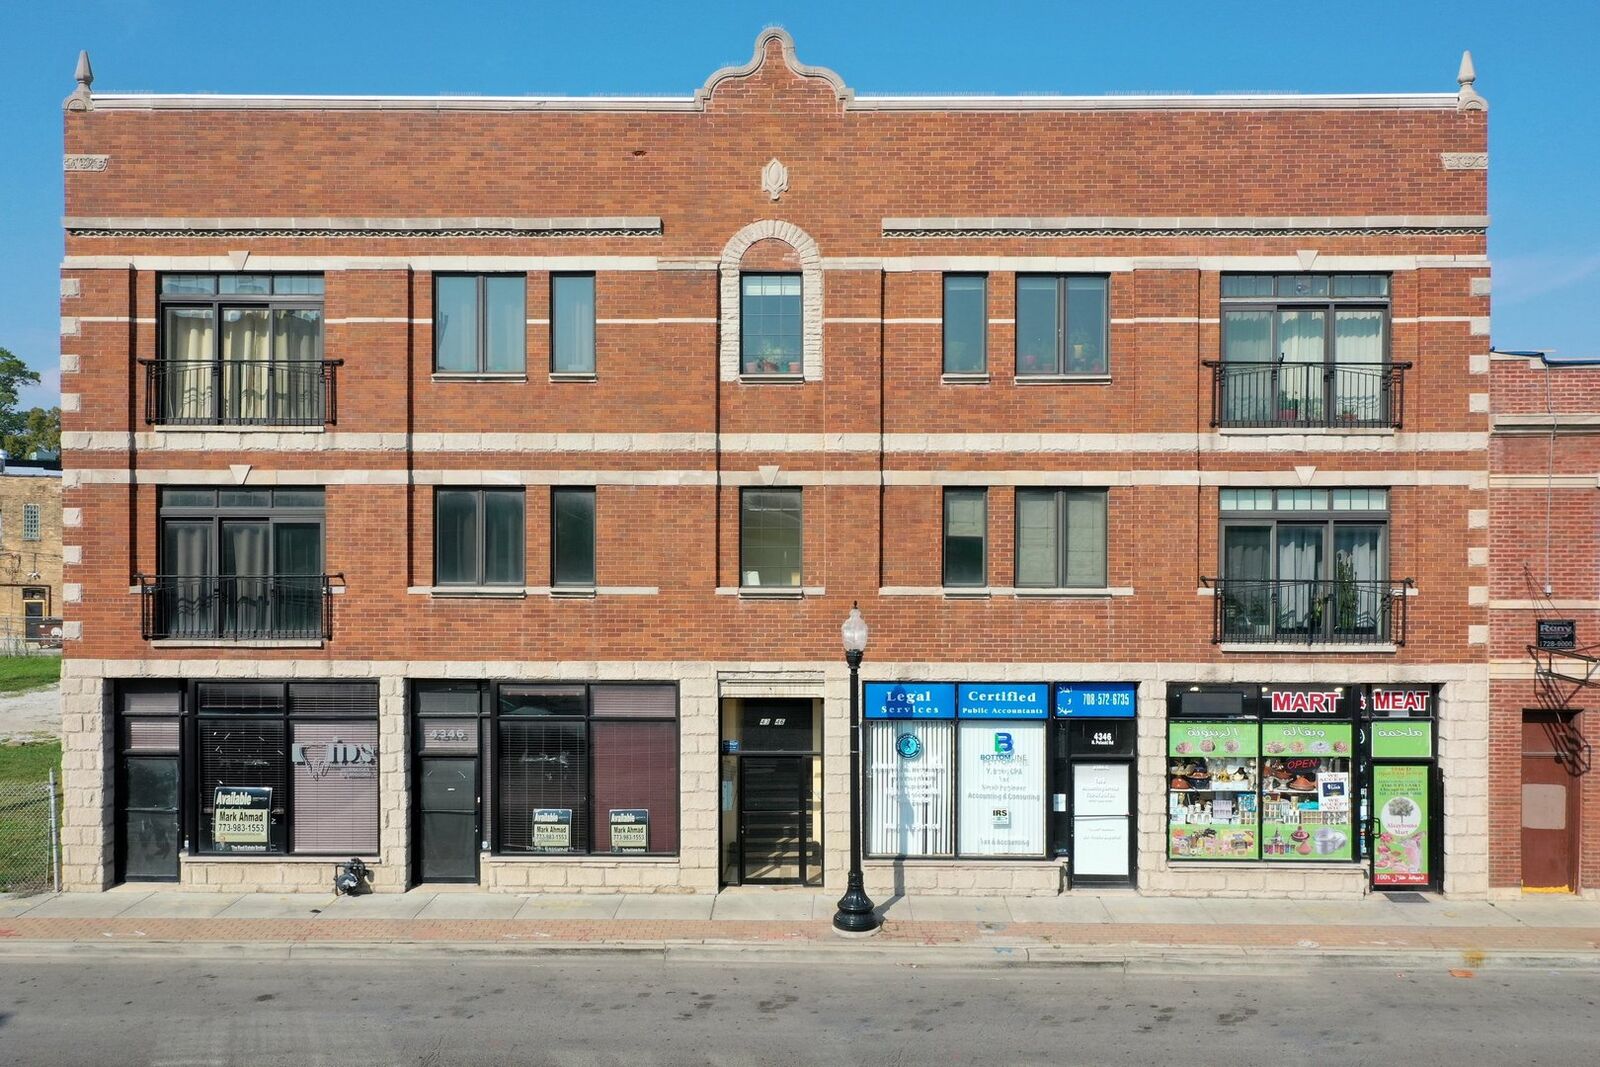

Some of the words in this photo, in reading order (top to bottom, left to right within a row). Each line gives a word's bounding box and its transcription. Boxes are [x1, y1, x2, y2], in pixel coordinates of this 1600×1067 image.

[887, 691, 931, 704] Legal
[968, 691, 1036, 702] Certified
[1083, 693, 1129, 706] 708-572-6735
[1272, 691, 1340, 713] MART
[1374, 691, 1429, 711] MEAT
[882, 705, 939, 714] Services
[430, 729, 464, 738] 4346
[1093, 732, 1112, 741] 4346
[1287, 759, 1317, 769] OPEN
[216, 791, 252, 805] Available
[219, 811, 237, 822] Mark
[239, 811, 264, 822] Ahmad
[992, 809, 1008, 817] IRS
[218, 823, 265, 832] 773-983-1553
